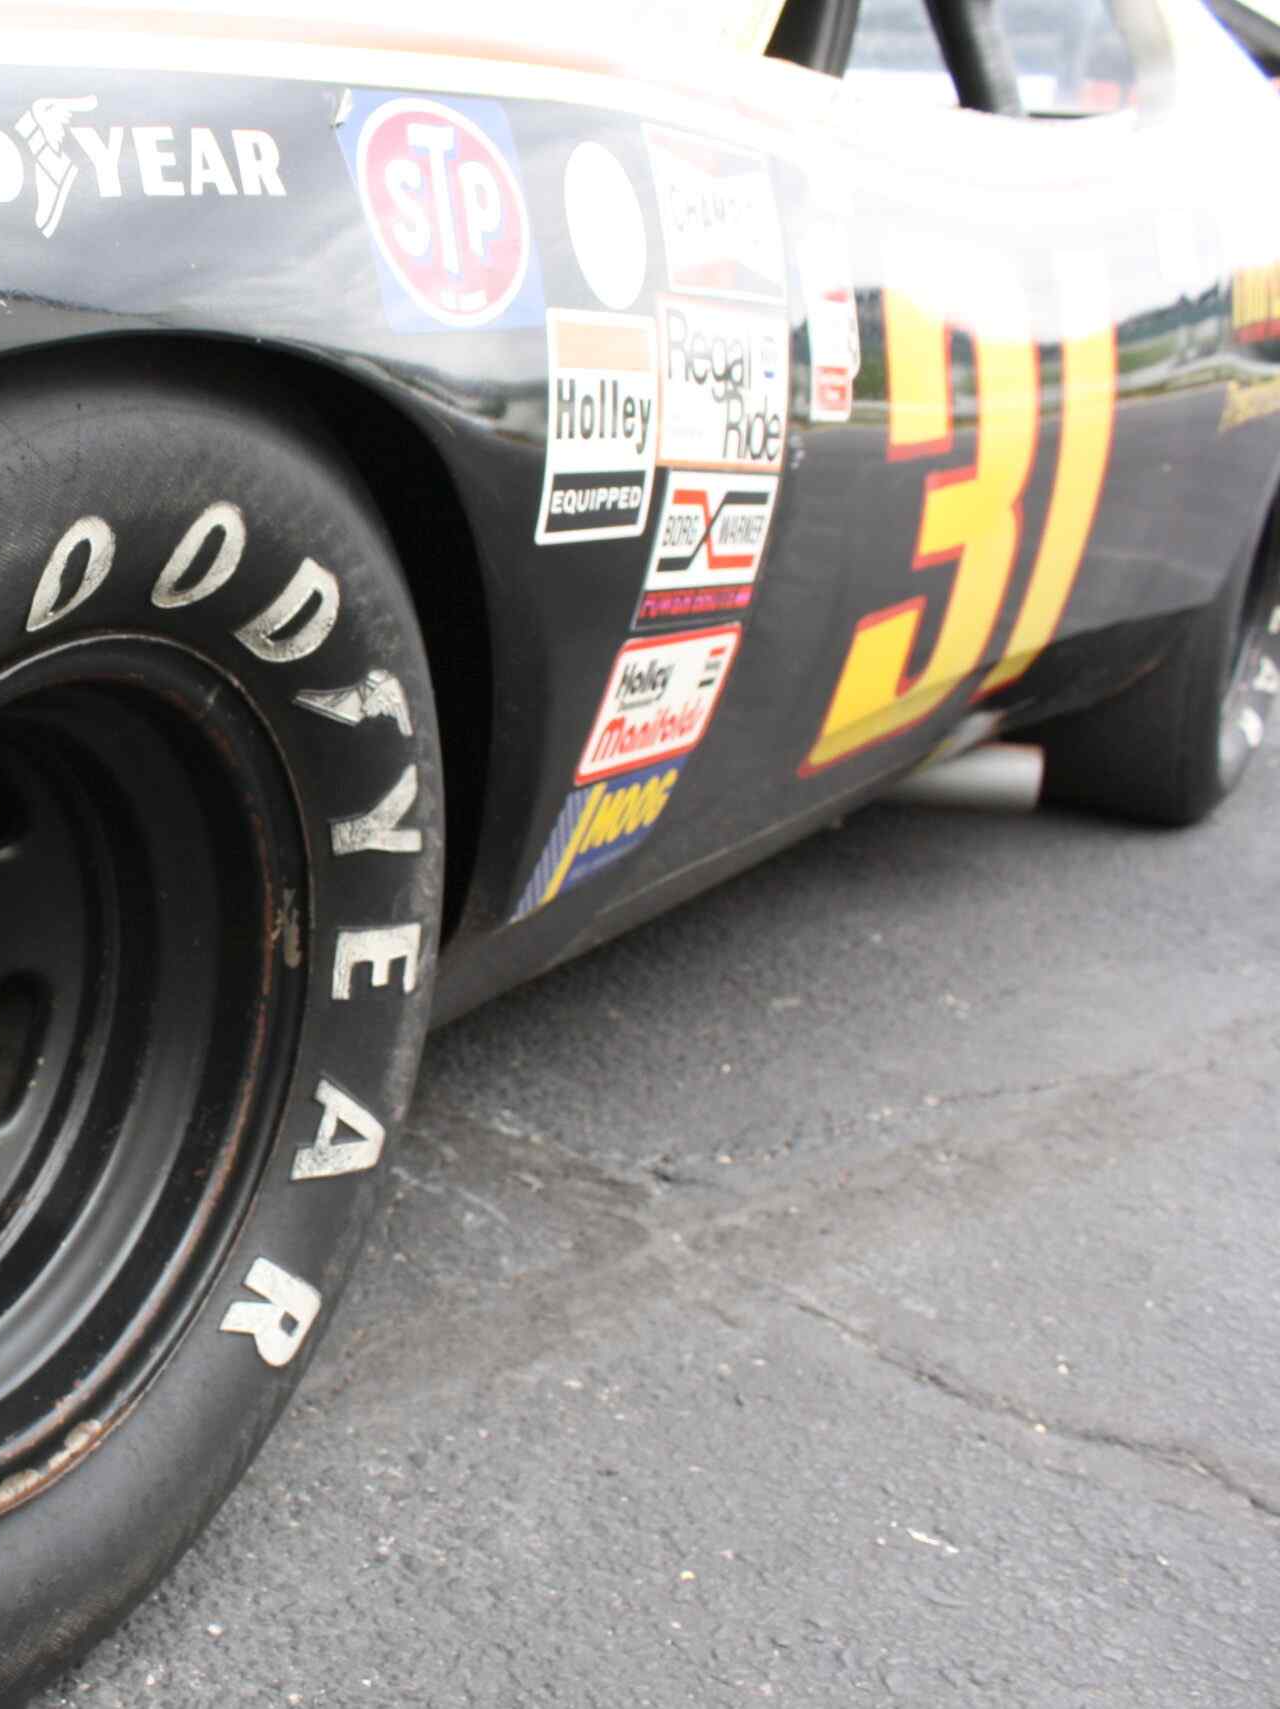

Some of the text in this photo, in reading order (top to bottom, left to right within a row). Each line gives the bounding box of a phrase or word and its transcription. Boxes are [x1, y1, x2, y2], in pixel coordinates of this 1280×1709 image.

[384, 124, 503, 276] STP
[666, 309, 752, 403] Regal
[556, 378, 652, 455] Holley
[721, 393, 781, 462] Ride
[550, 485, 643, 515] EQUIPPED
[617, 658, 675, 702] Holley
